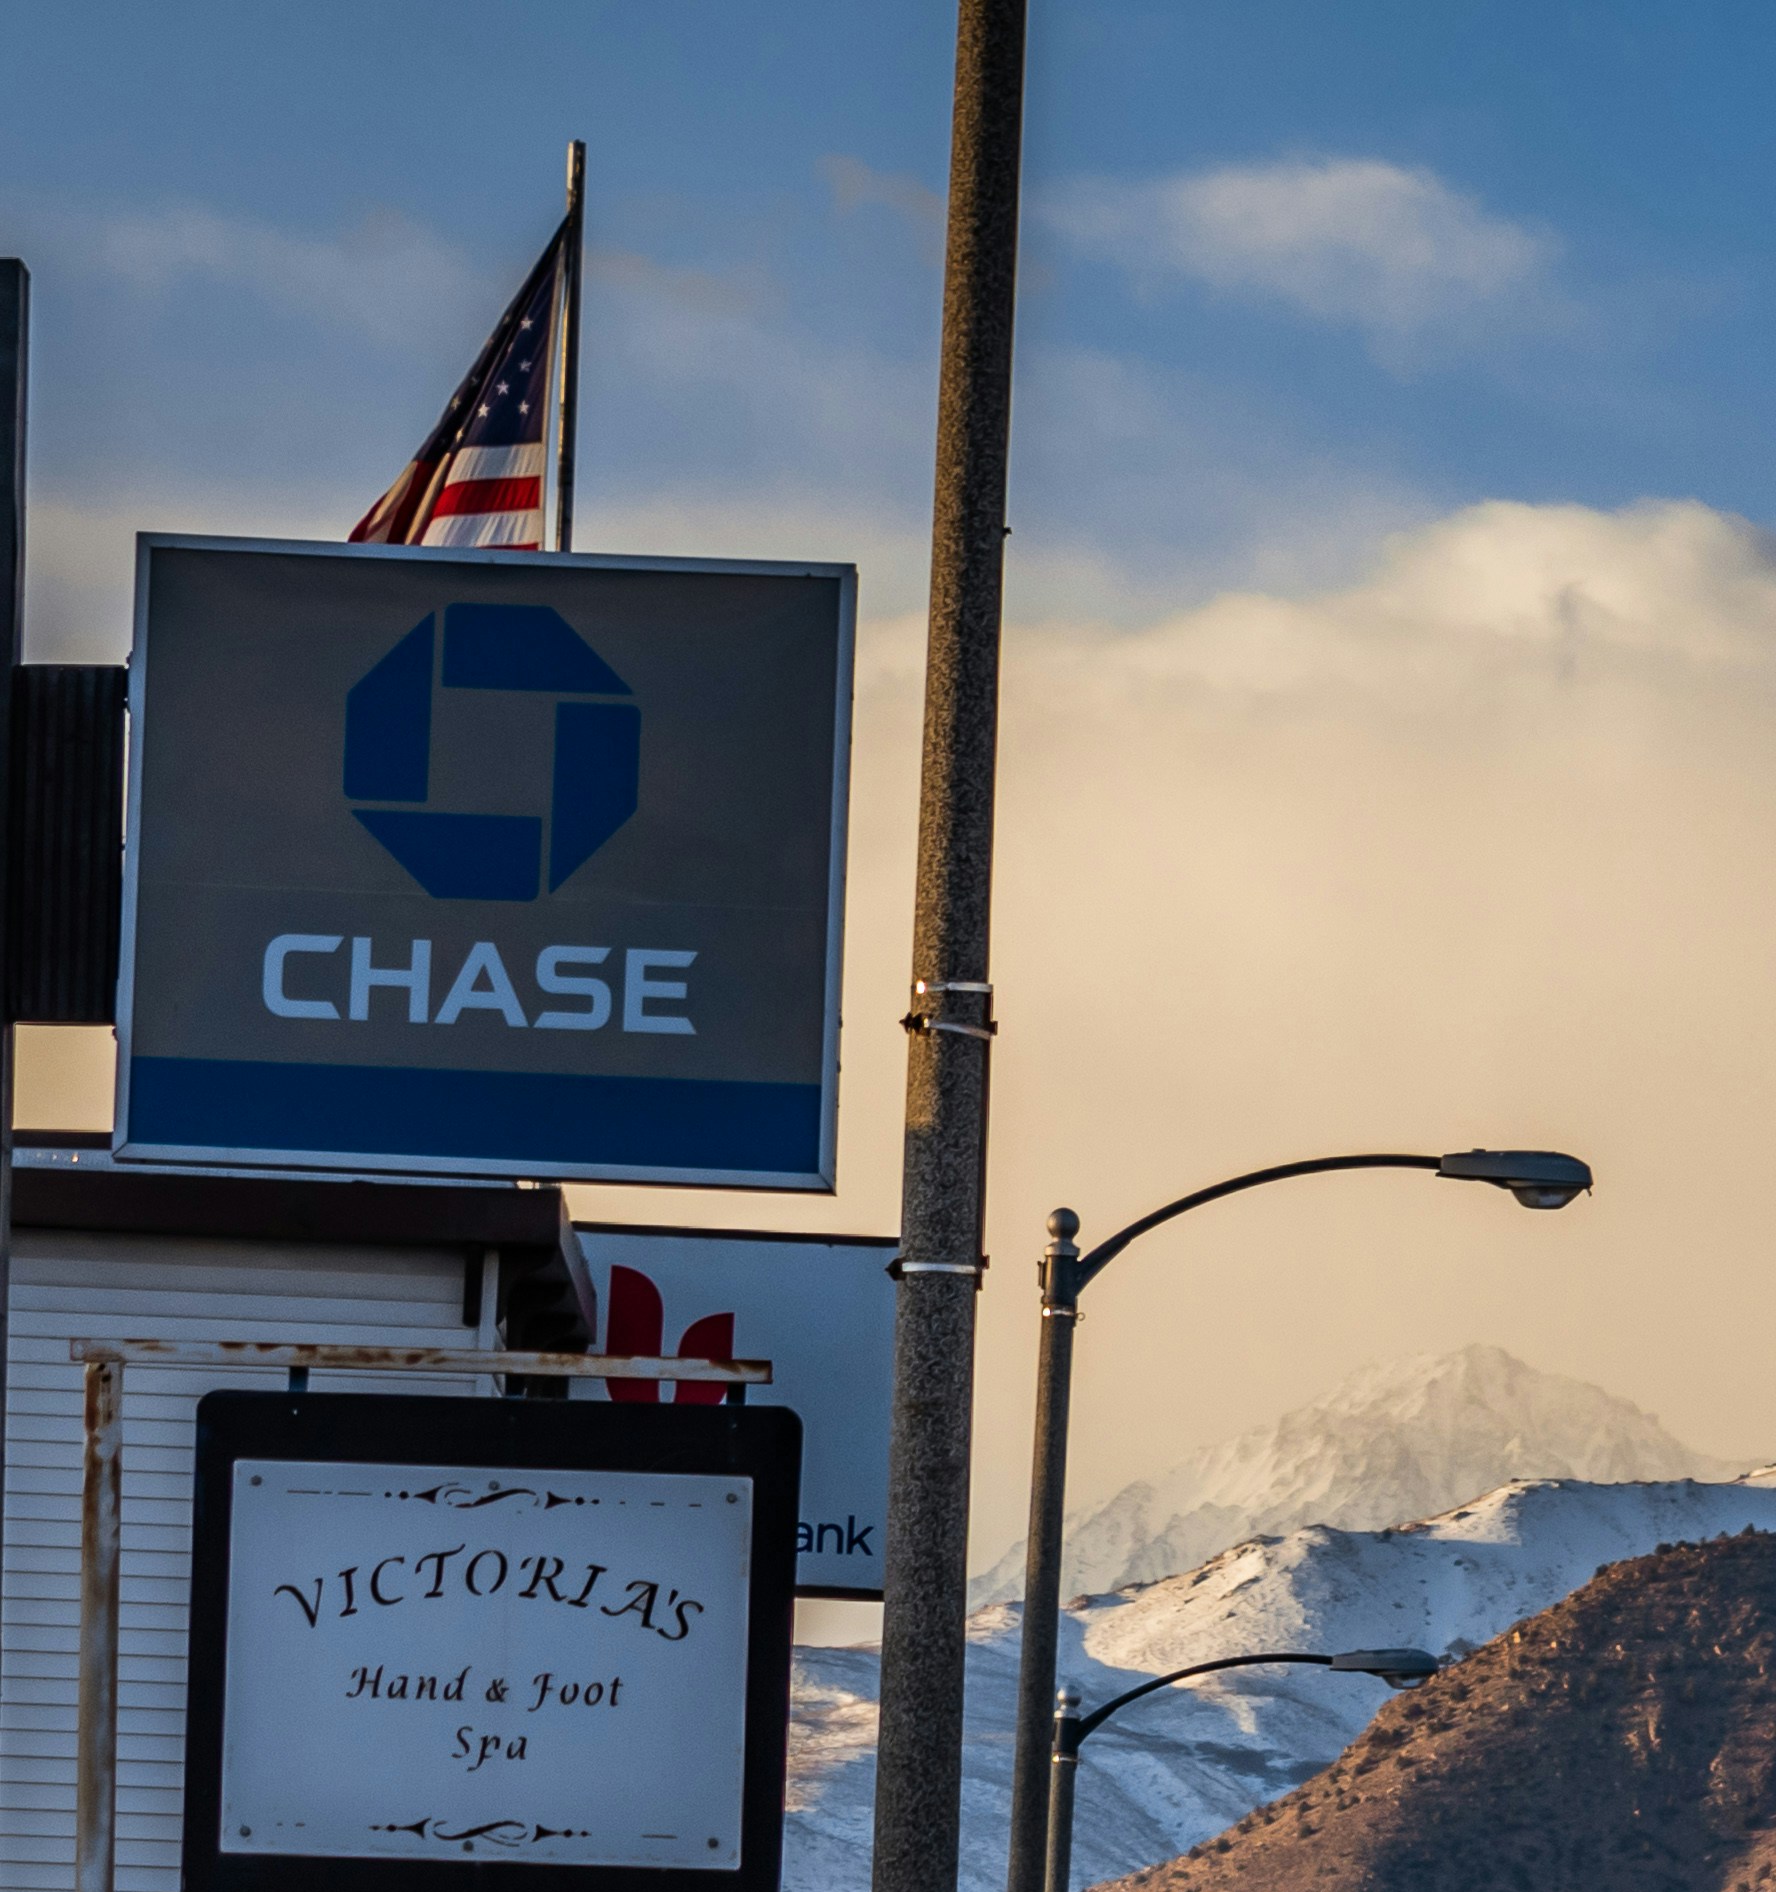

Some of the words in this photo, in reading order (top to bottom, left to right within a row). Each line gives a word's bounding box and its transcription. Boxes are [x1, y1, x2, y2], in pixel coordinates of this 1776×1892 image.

[262, 934, 698, 1035] CHASE
[795, 1516, 874, 1558] ank
[273, 1544, 705, 1641] VICTORIA'S
[346, 1666, 475, 1703] Hand
[485, 1677, 511, 1703] &
[528, 1667, 625, 1712] Foot
[451, 1725, 529, 1773] Spa
